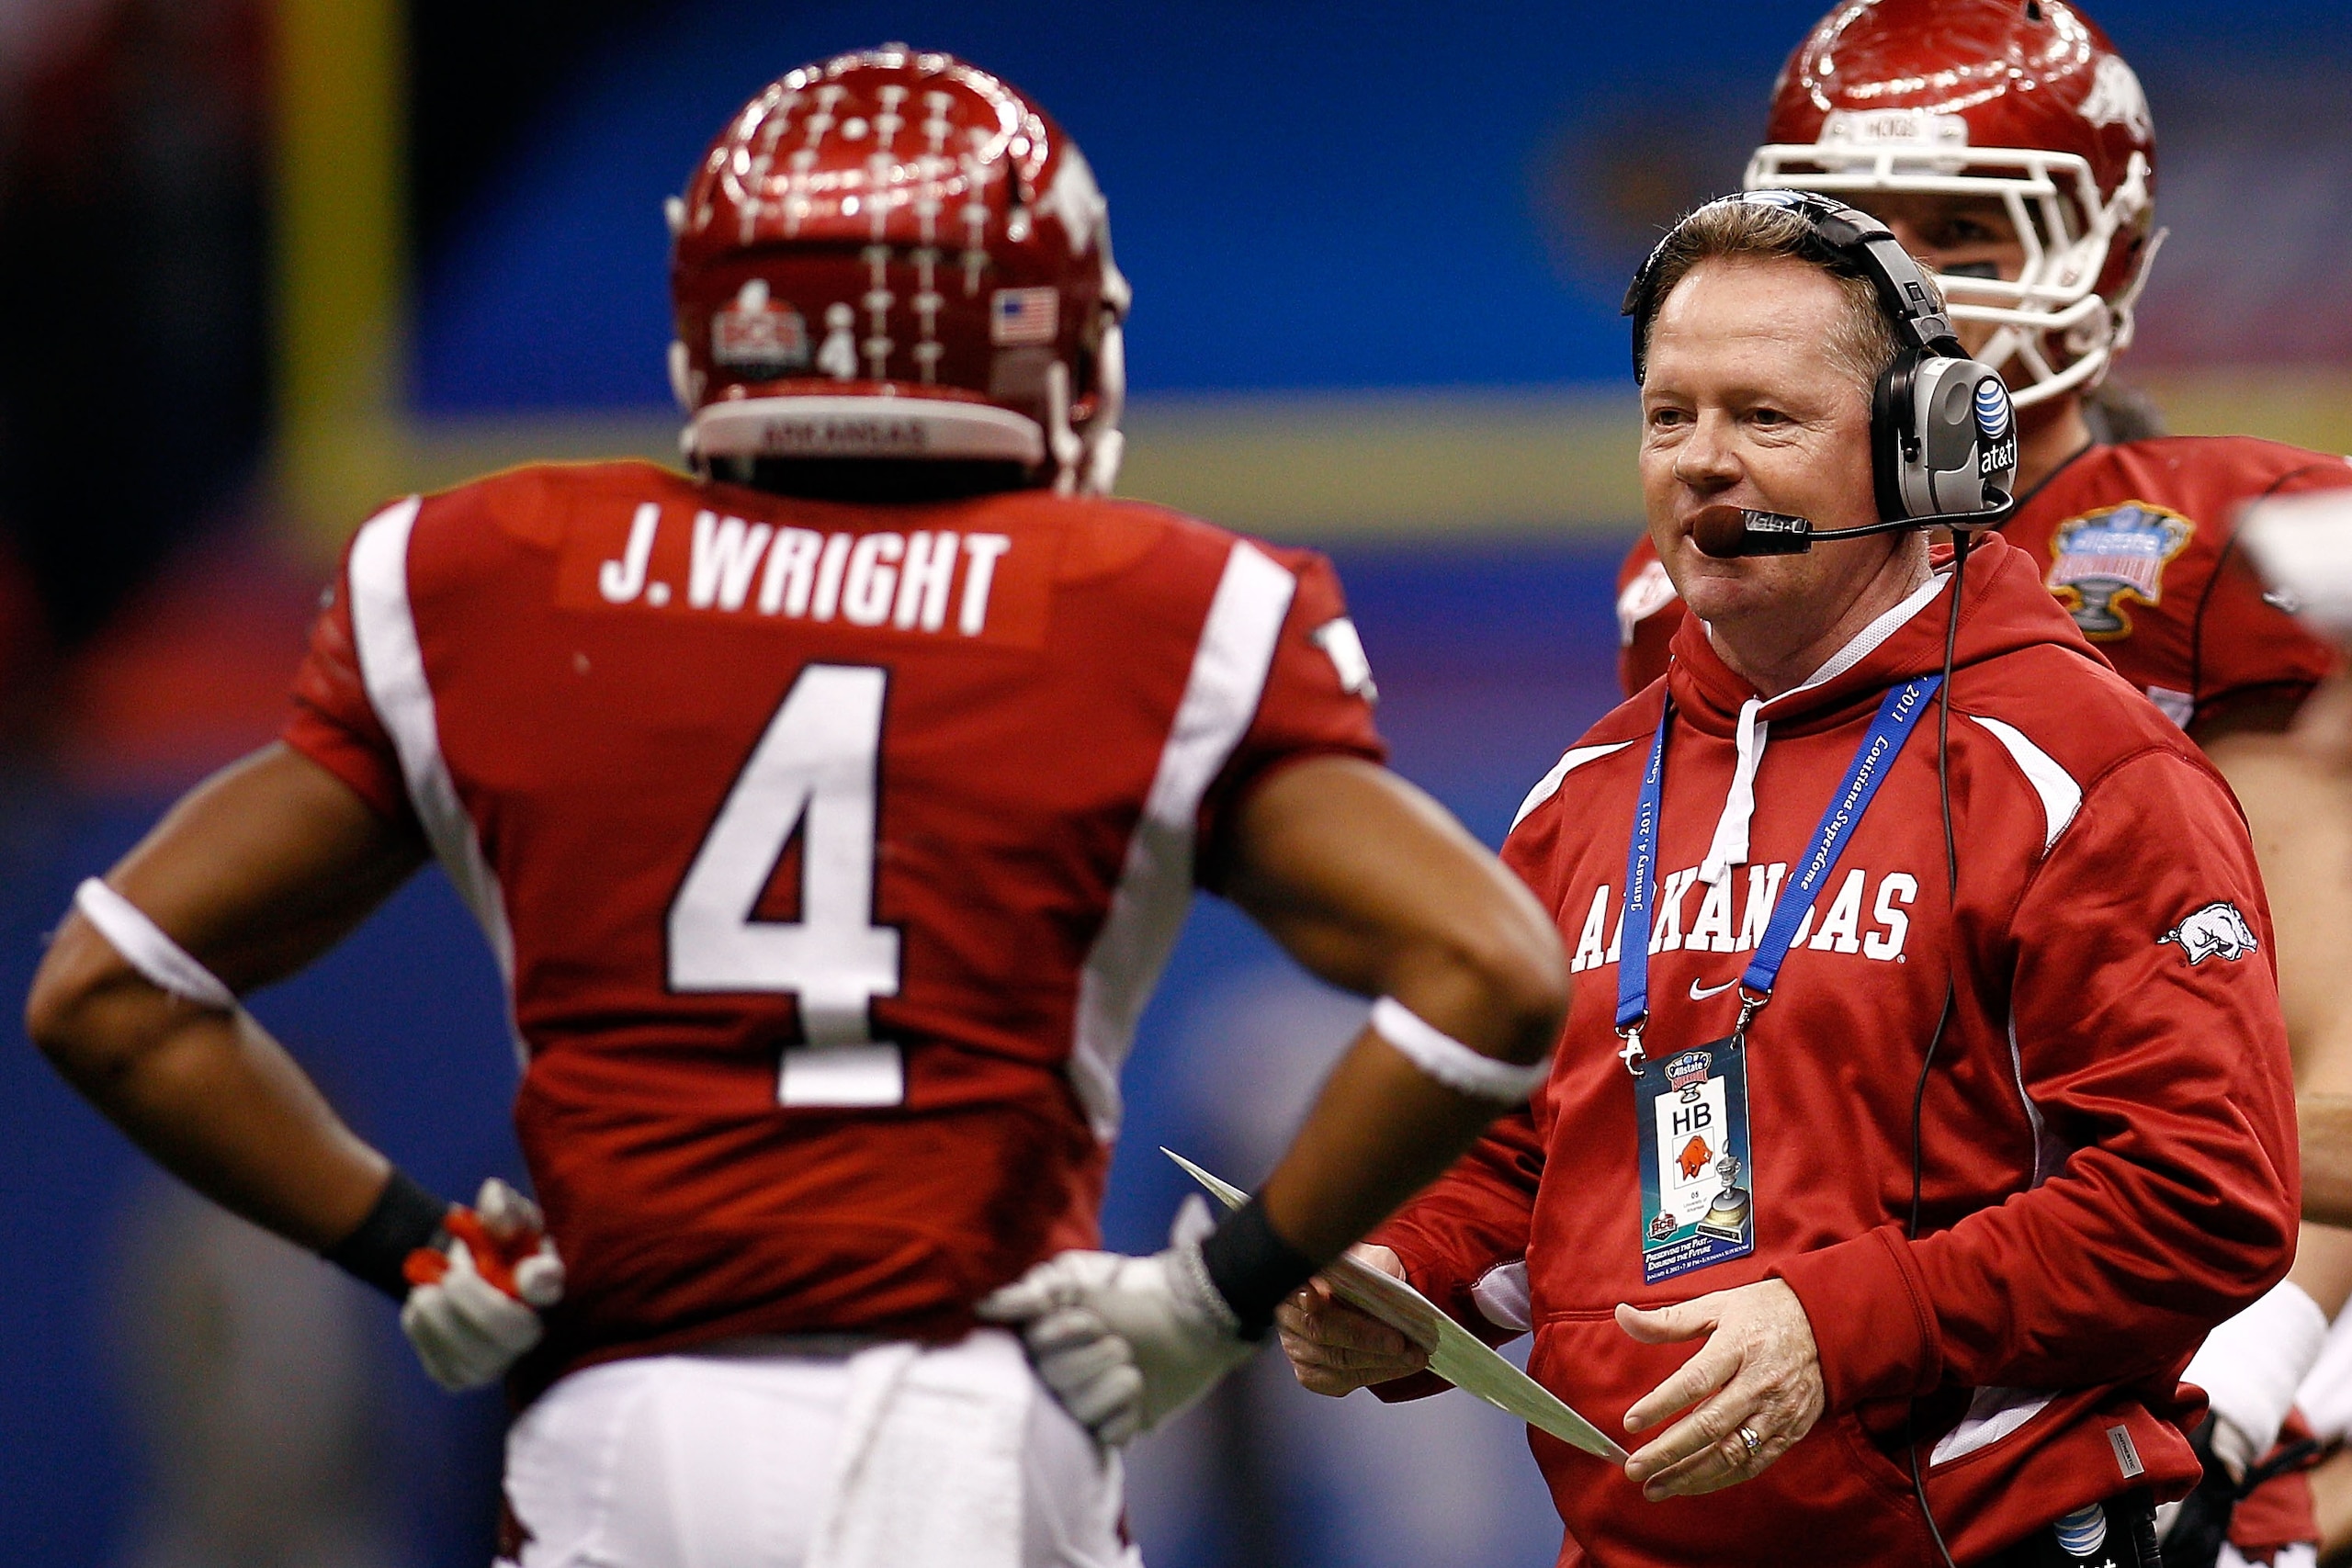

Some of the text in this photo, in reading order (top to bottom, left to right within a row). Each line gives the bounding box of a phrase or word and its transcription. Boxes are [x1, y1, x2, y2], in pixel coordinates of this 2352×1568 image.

[1982, 439, 2013, 473] at&t
[598, 502, 1012, 637] J. WRIGHT
[1801, 684, 1920, 891] 2011 Louisiana Superdome
[1639, 801, 1651, 836] 2011
[666, 662, 904, 1108] 4
[1631, 854, 1649, 912] January
[1672, 1102, 1712, 1135] HB
